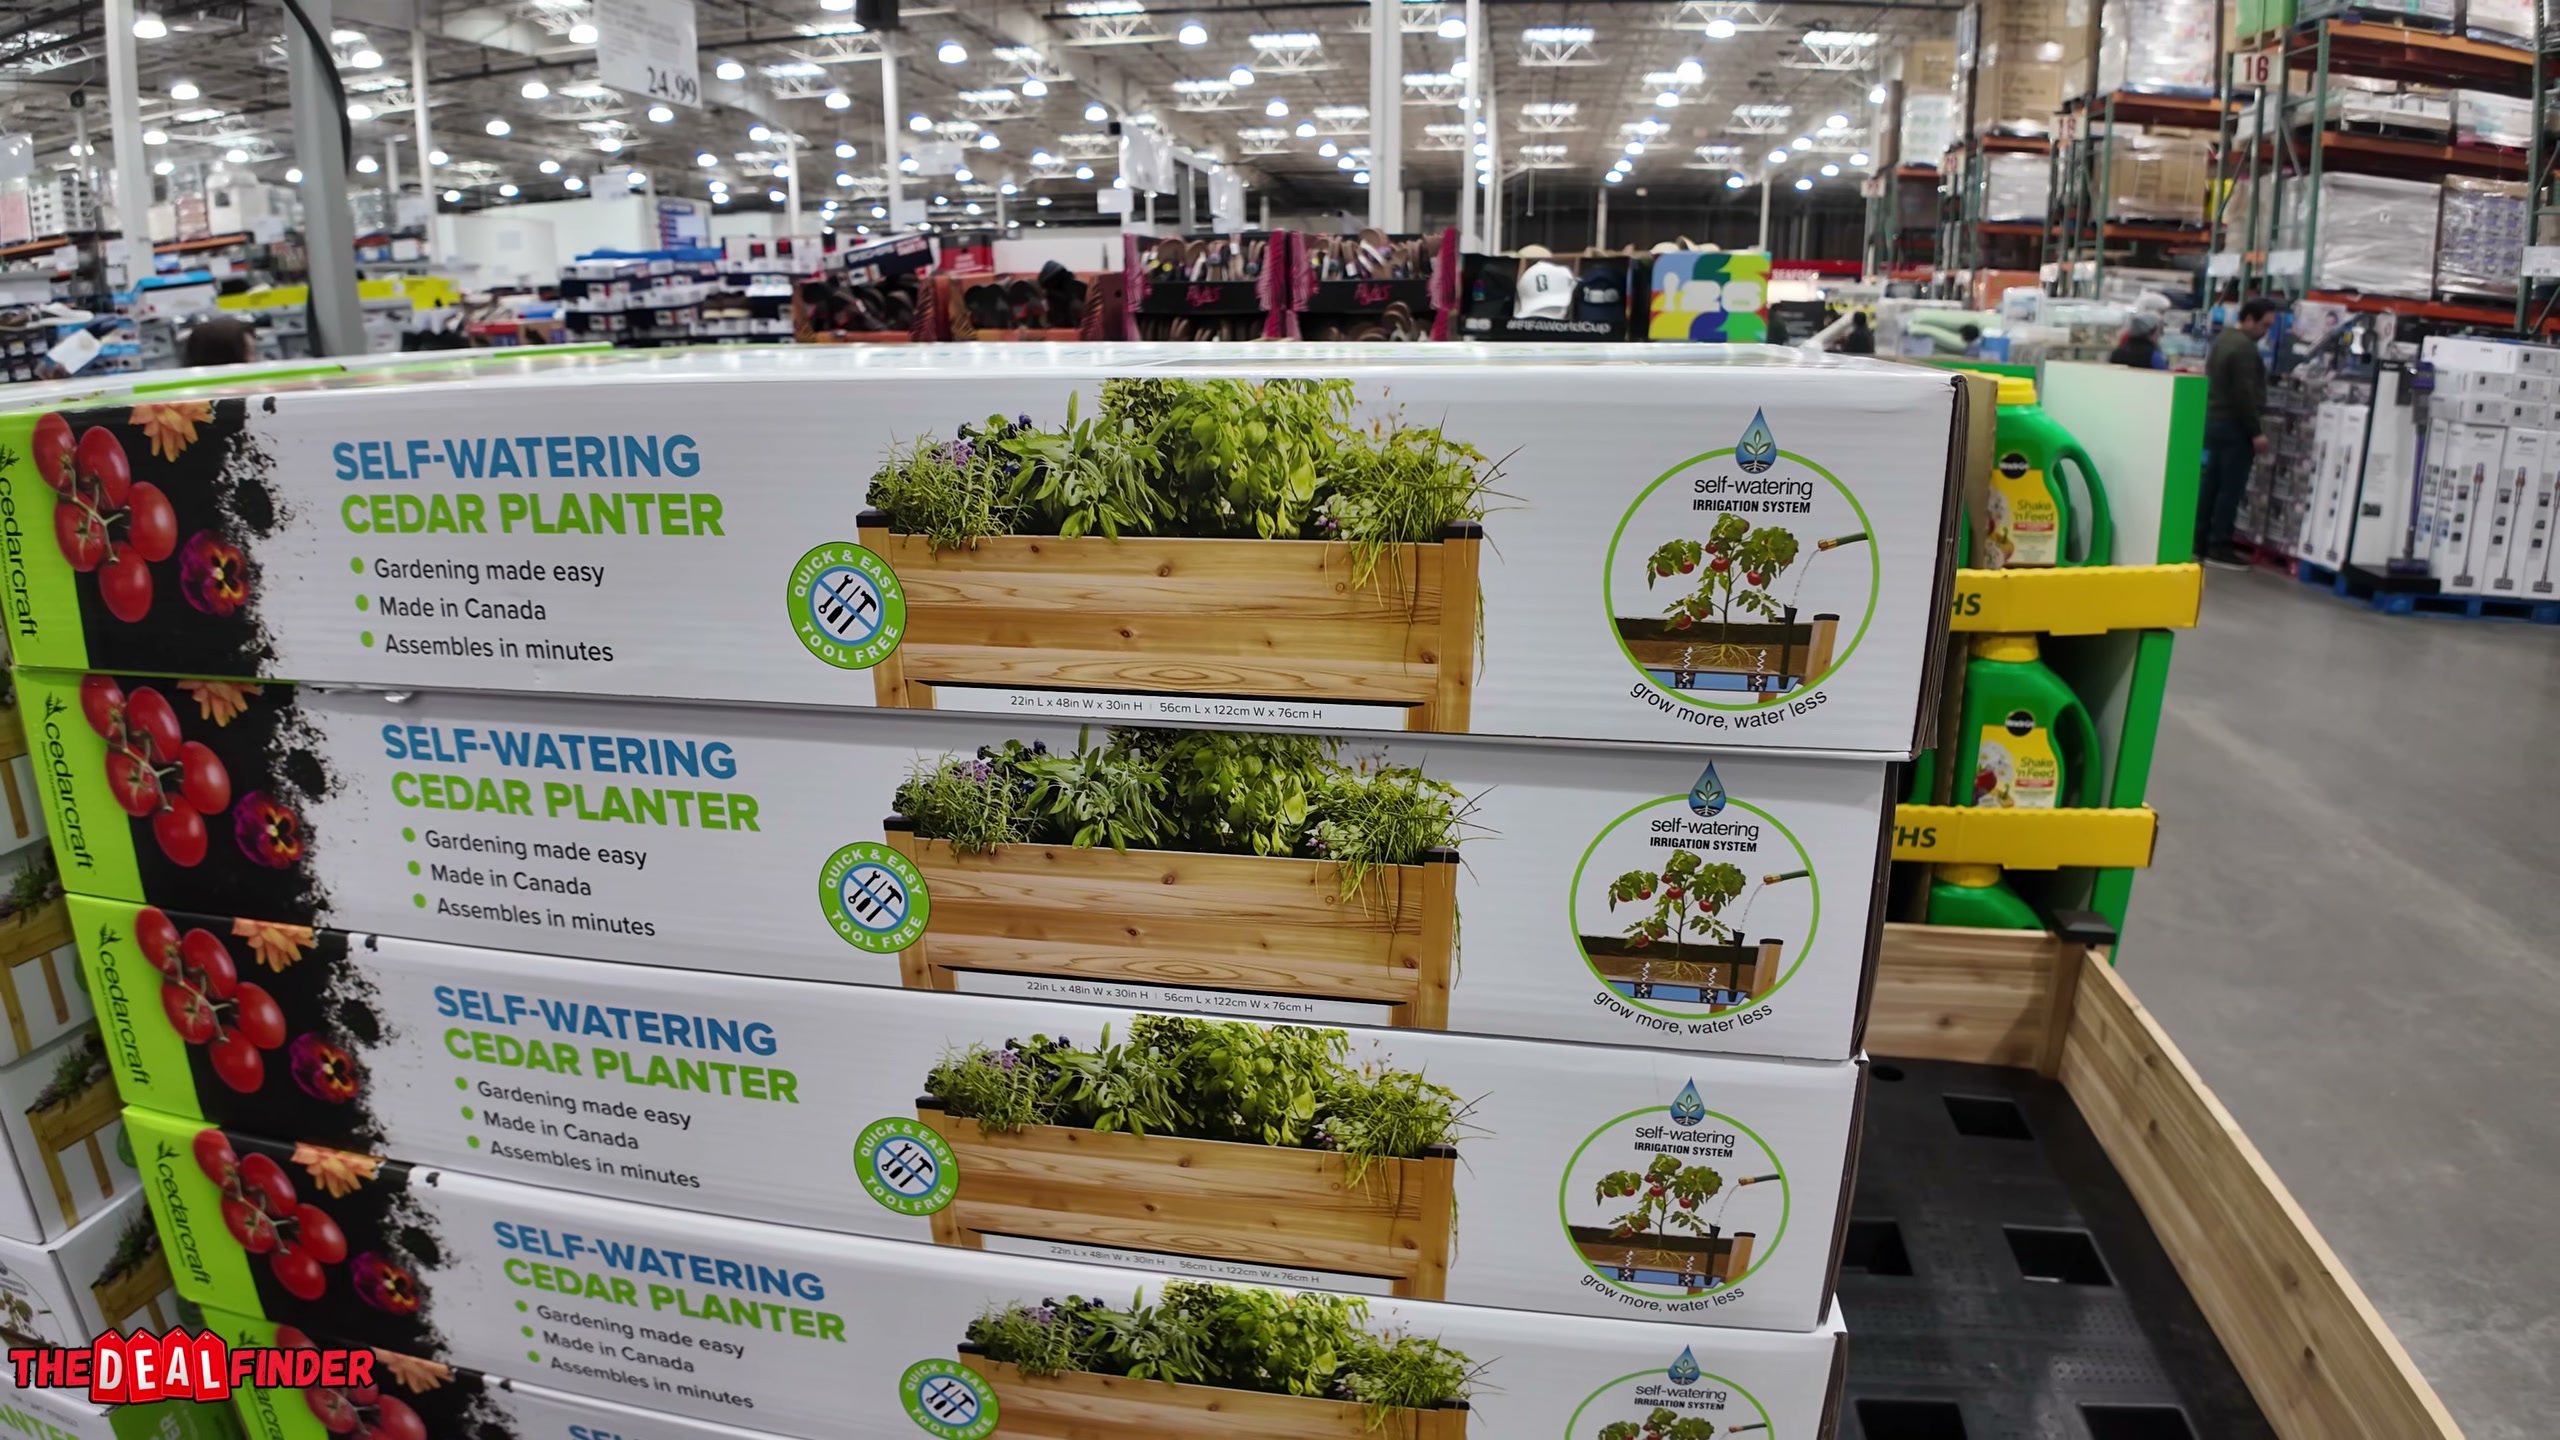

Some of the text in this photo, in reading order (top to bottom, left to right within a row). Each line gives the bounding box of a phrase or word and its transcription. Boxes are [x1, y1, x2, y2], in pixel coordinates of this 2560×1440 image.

[646, 64, 697, 104] 24.99
[2244, 56, 2268, 82] 16
[332, 434, 700, 481] SELF-WATERING
[1692, 499, 1810, 513] IRRIGATION SYSTEM
[1694, 476, 1813, 500] self-watering
[2017, 500, 2052, 510] Shake
[341, 493, 726, 536] CEDAR PLANTER
[0, 477, 38, 637] cedarcraft
[374, 558, 604, 587] Gardening made easy
[794, 550, 898, 600] QUICK & EASY
[380, 596, 546, 620] Made in Canada
[385, 634, 614, 662] Assembles in minutes
[801, 622, 898, 662] TOOL FREE
[1011, 696, 1034, 706] 22in
[1038, 698, 1044, 706] L
[1056, 698, 1079, 708] 48in
[1082, 700, 1094, 709] W
[1106, 700, 1130, 710] 30in
[1134, 702, 1143, 711] H
[1160, 702, 1191, 713] 56cm
[1194, 704, 1201, 713] L
[1204, 706, 1210, 714] x
[1214, 705, 1250, 716] 122cm
[1253, 707, 1265, 717] W
[1278, 708, 1309, 718] 76cm
[1313, 710, 1322, 719] H
[1630, 682, 1827, 730] grow more, water less
[381, 724, 738, 780] SELF-WATERING
[2021, 756, 2053, 767] Shake
[45, 722, 94, 869] cedarcraft
[392, 771, 761, 832] CEDAR PLANTER
[1650, 837, 1757, 852] IRRIGATION SYSTEM
[1651, 818, 1759, 840] self-watering
[425, 830, 647, 870] Gardening made easy
[431, 863, 591, 896] Made in Canada
[826, 849, 922, 895] QUICK & EASY
[437, 898, 655, 937] Assembles in minutes
[832, 910, 921, 947] TOOL FREE
[1026, 982, 1048, 991] 22in
[1052, 984, 1057, 992] L
[1068, 985, 1090, 995] 48in
[1093, 987, 1104, 995] W
[1115, 988, 1137, 998] 30in
[1140, 990, 1148, 999] H
[1164, 993, 1193, 1002] 56cm
[1196, 995, 1202, 1003] L
[1214, 996, 1247, 1007] 122cm
[1250, 999, 1261, 1008] W
[1272, 1002, 1301, 1011] 76cm
[1304, 1004, 1313, 1012] H
[1594, 991, 1772, 1035] grow more, water less
[100, 950, 150, 1085] cedarcraft
[434, 985, 777, 1056] SELF-WATERING
[444, 1028, 800, 1104] CEDAR PLANTER
[477, 1081, 691, 1130] Gardening made easy
[484, 1110, 639, 1149] Made in Canada
[861, 1123, 952, 1166] QUICK & EASY
[1635, 1126, 1735, 1148] self-watering
[491, 1140, 700, 1188] Assembles in minutes
[1634, 1142, 1733, 1158] IRRIGATION SYSTEM
[867, 1176, 952, 1211] TOOL FREE
[158, 1163, 212, 1285] cedarcraft
[494, 1221, 825, 1301] SELF-WATERING
[1179, 1260, 1206, 1270] 56cm
[1210, 1264, 1215, 1272] L
[1226, 1266, 1258, 1277] 122cm
[1260, 1269, 1271, 1278] W
[1282, 1272, 1308, 1282] 76cm
[1311, 1275, 1319, 1283] H
[504, 1258, 847, 1342] CEDAR PLANTER
[1581, 1273, 1744, 1313] grow more, water less
[537, 1304, 744, 1359] Gardening made easy
[543, 1330, 694, 1373] Made in Canada
[551, 1356, 754, 1408] Assembles in minutes
[906, 1364, 993, 1402] QUICK & EASY
[1636, 1384, 1727, 1402] self-watering
[913, 1407, 992, 1438] TOOL FREE
[1634, 1397, 1724, 1410] IRRIGATION SYSTEM
